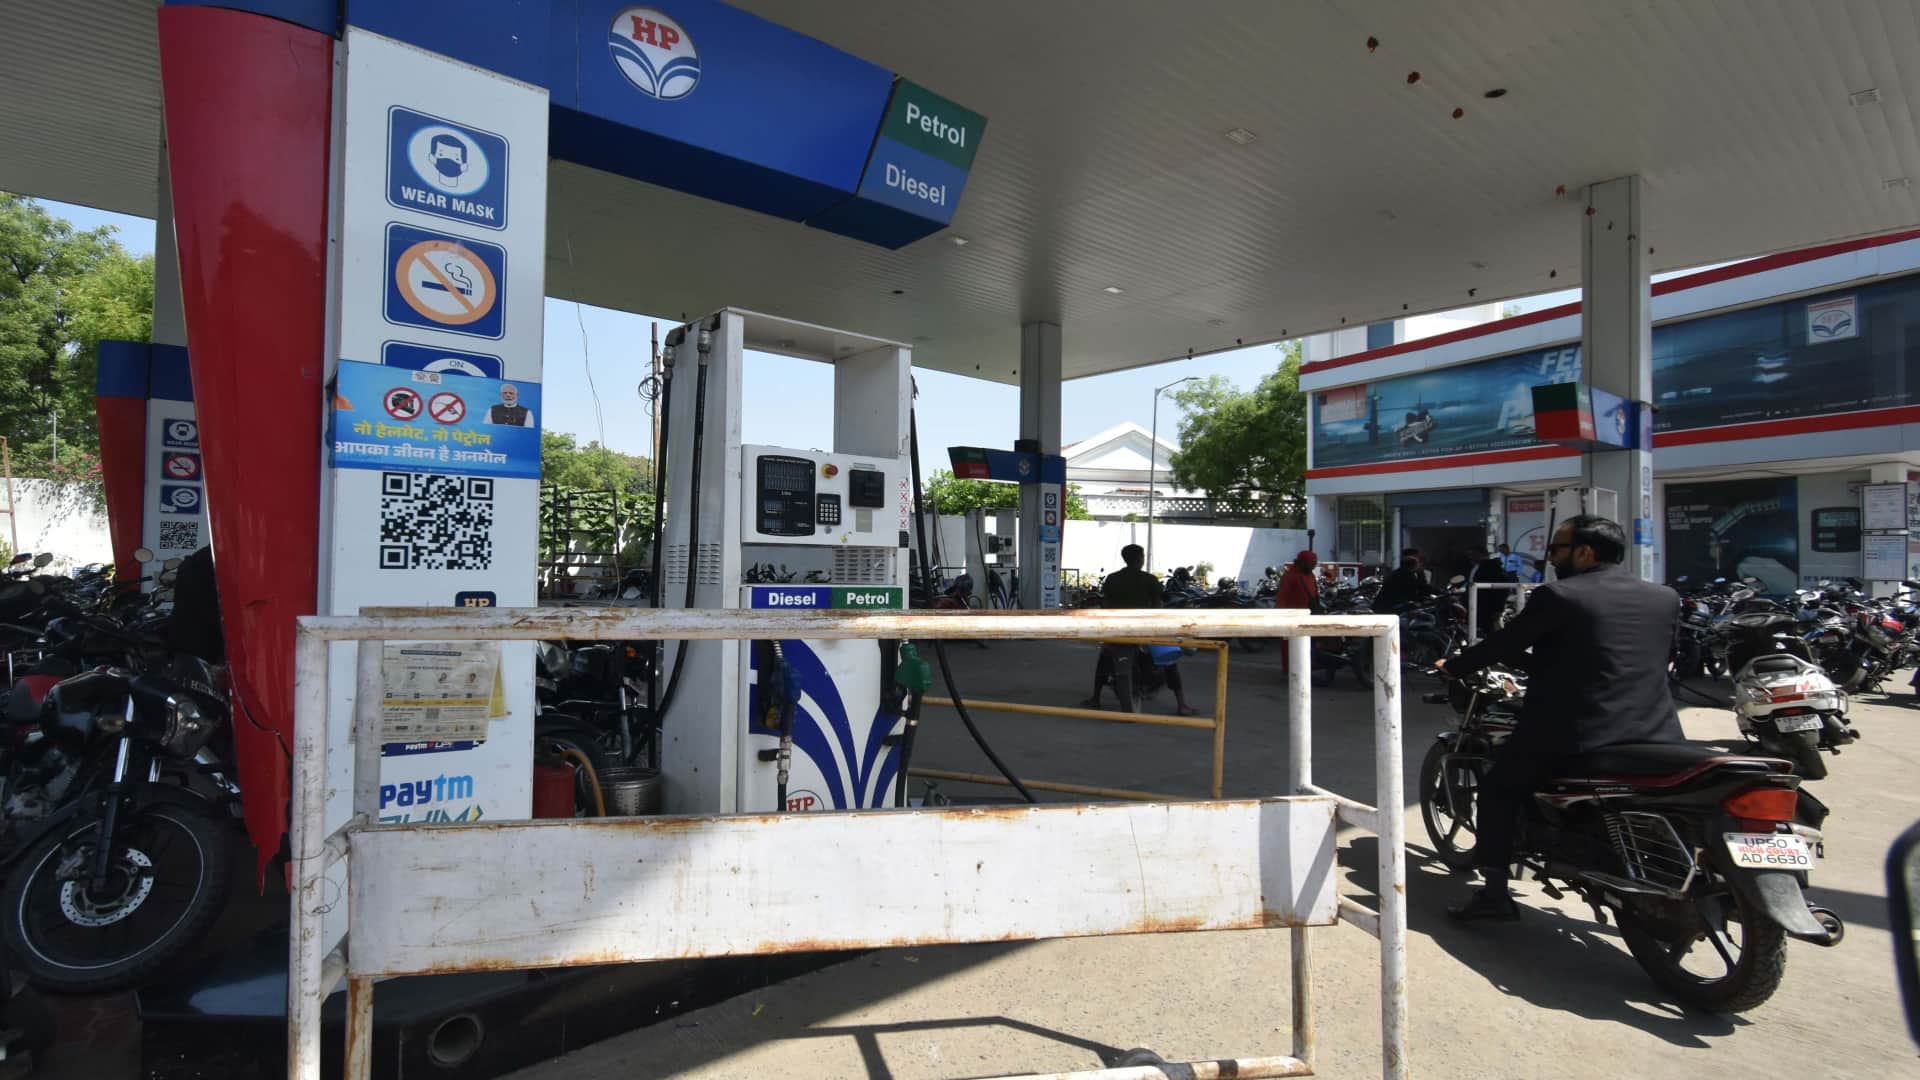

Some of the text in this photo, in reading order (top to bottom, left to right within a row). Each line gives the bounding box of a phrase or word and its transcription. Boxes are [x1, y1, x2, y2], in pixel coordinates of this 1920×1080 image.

[631, 15, 680, 51] HP
[906, 101, 966, 148] Petrol
[885, 162, 946, 207] Diesel
[400, 185, 495, 220] WEAR MASK
[449, 359, 465, 369] ON
[352, 420, 372, 436] नो
[431, 427, 449, 442] नो
[451, 427, 491, 446] पेट्रोल
[335, 440, 507, 465] आपका जीवन है अनमोल
[464, 597, 490, 608] HP
[768, 592, 816, 606] Diesel
[846, 592, 889, 605] Petrol
[787, 796, 815, 812] HP
[1744, 837, 1788, 849] UP50
[1766, 847, 1801, 855] COURT
[1741, 853, 1808, 865] AD 6630
